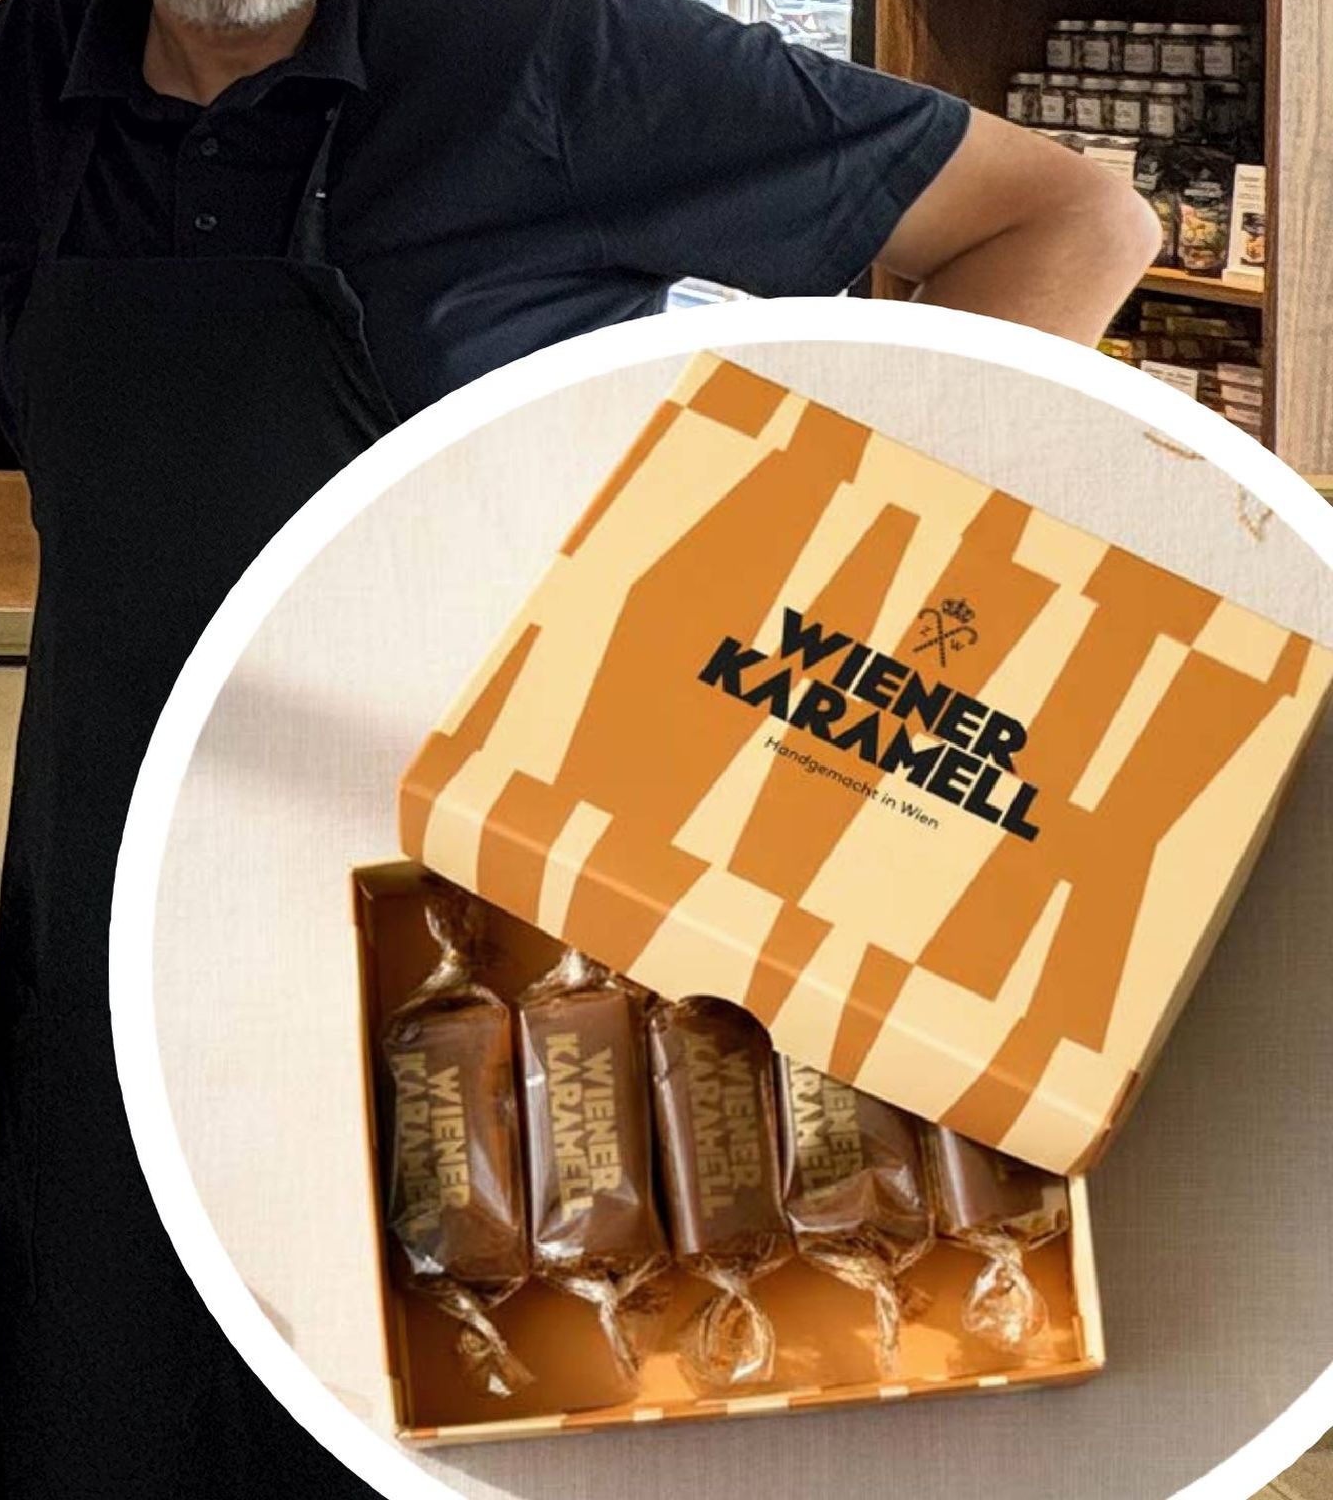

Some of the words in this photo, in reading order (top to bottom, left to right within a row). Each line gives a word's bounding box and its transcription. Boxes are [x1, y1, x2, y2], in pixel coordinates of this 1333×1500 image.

[697, 636, 1041, 843] KARAMELL
[779, 606, 1026, 775] WIENER
[764, 736, 879, 801] Handgemacht
[880, 792, 897, 811] in
[900, 801, 939, 830] Wien
[545, 1033, 594, 1222] KARAMELL
[581, 1047, 622, 1191] WIENER
[685, 1035, 735, 1220] KARAMELL
[720, 1050, 762, 1190] WIENER
[791, 1070, 837, 1200] RAMELL
[822, 1078, 864, 1180] IENER
